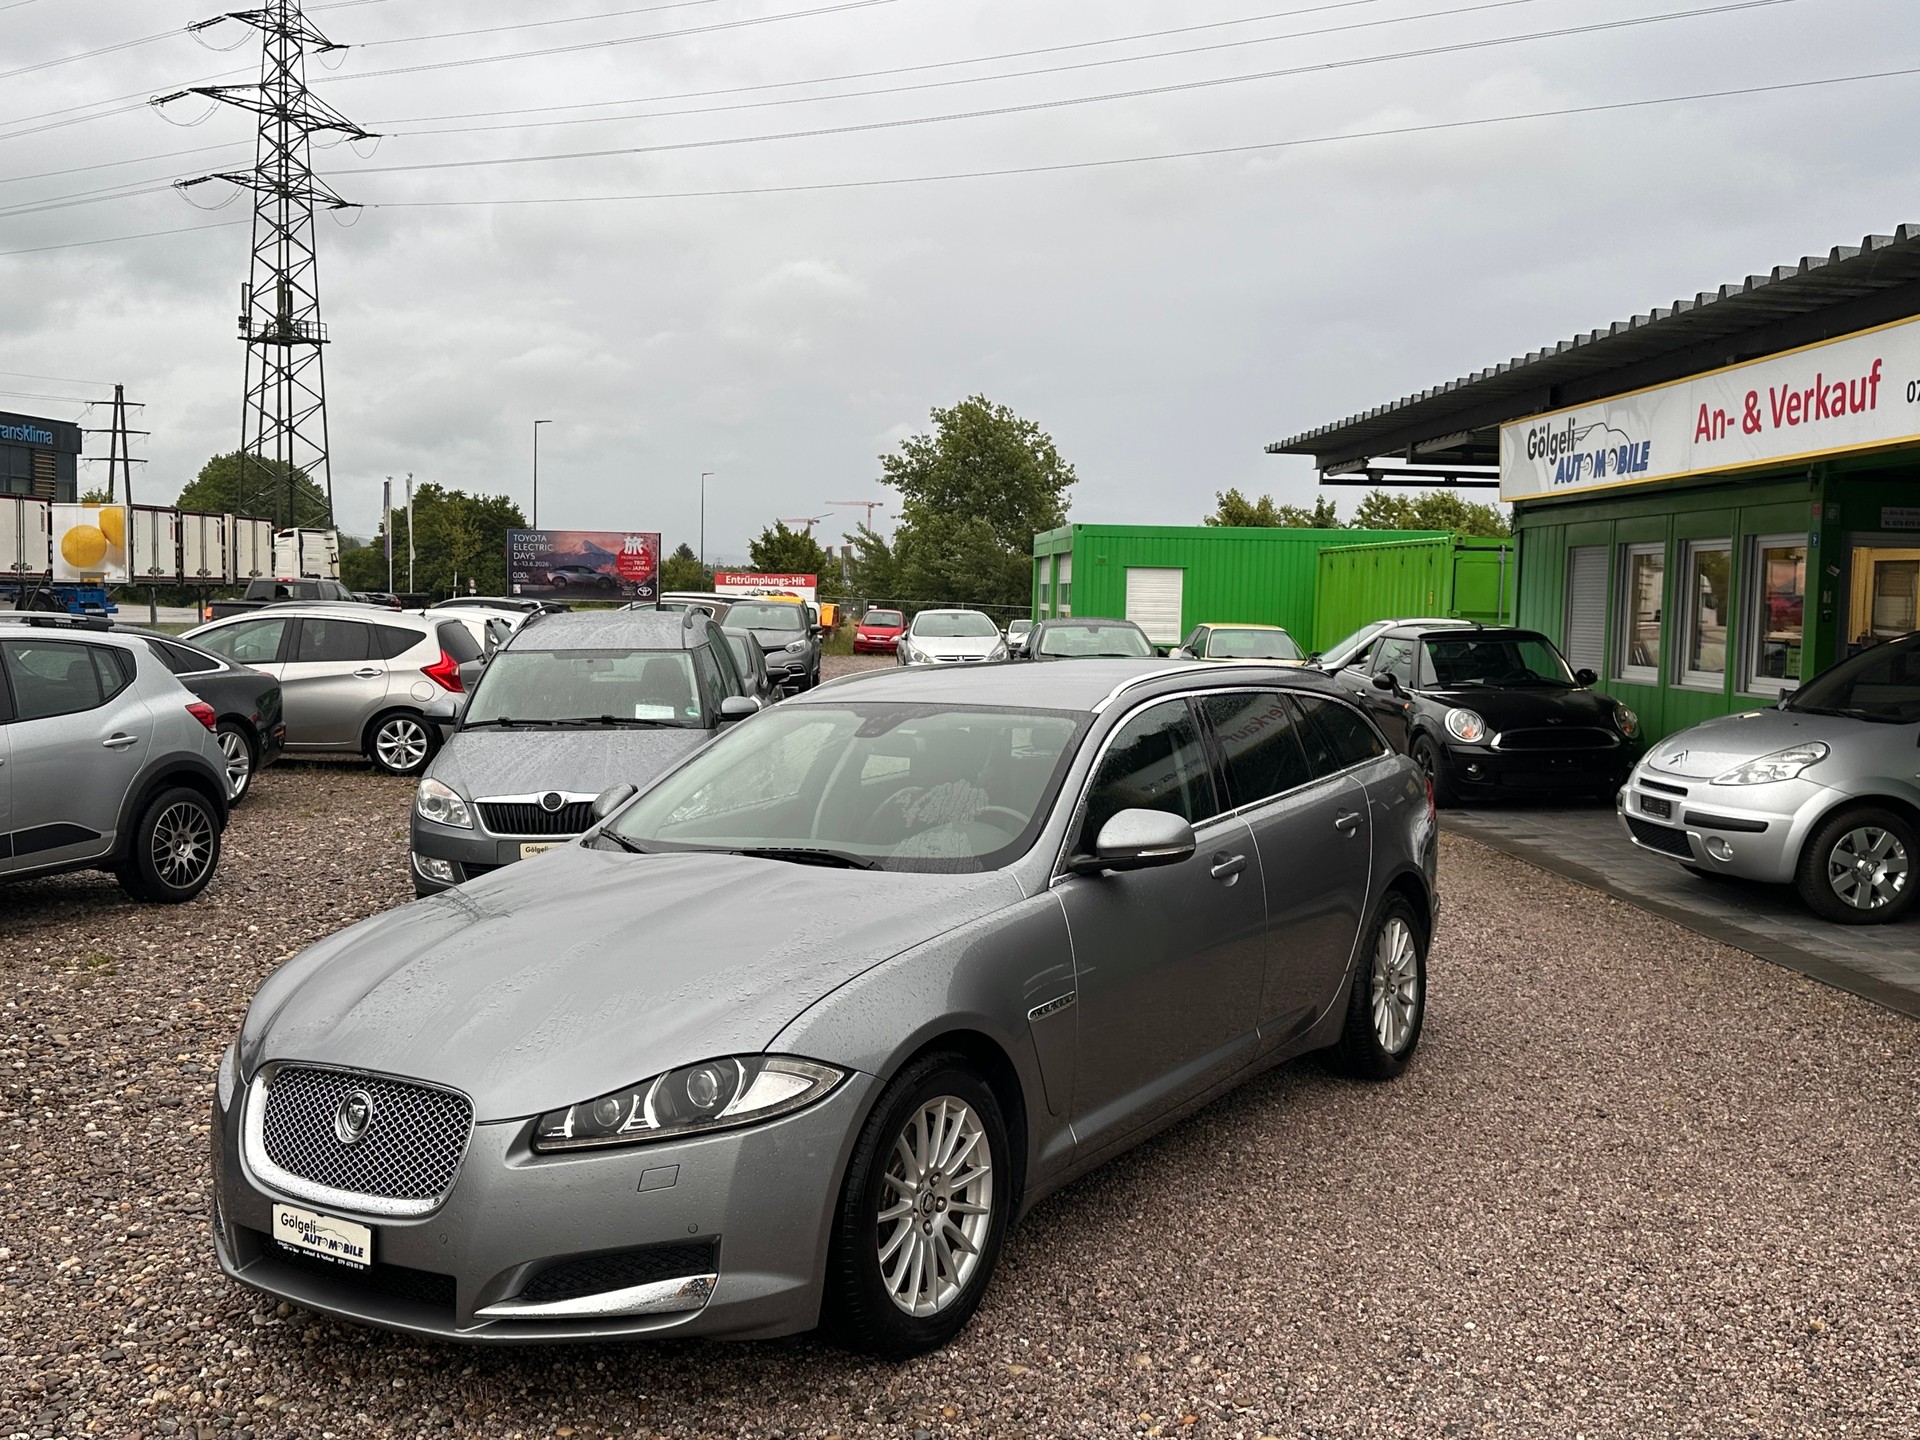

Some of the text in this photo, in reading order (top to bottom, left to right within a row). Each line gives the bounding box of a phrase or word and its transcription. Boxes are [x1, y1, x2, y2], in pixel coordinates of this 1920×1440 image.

[1695, 357, 1883, 444] An- & Verkauf
[1526, 416, 1575, 466] Gölgeli
[513, 534, 547, 542] TOYOTA
[513, 543, 554, 551] ELECTRIC
[513, 552, 536, 560] DAYS
[725, 575, 806, 587] Entrümplungs-Hit
[280, 1212, 316, 1234] Gölgeli
